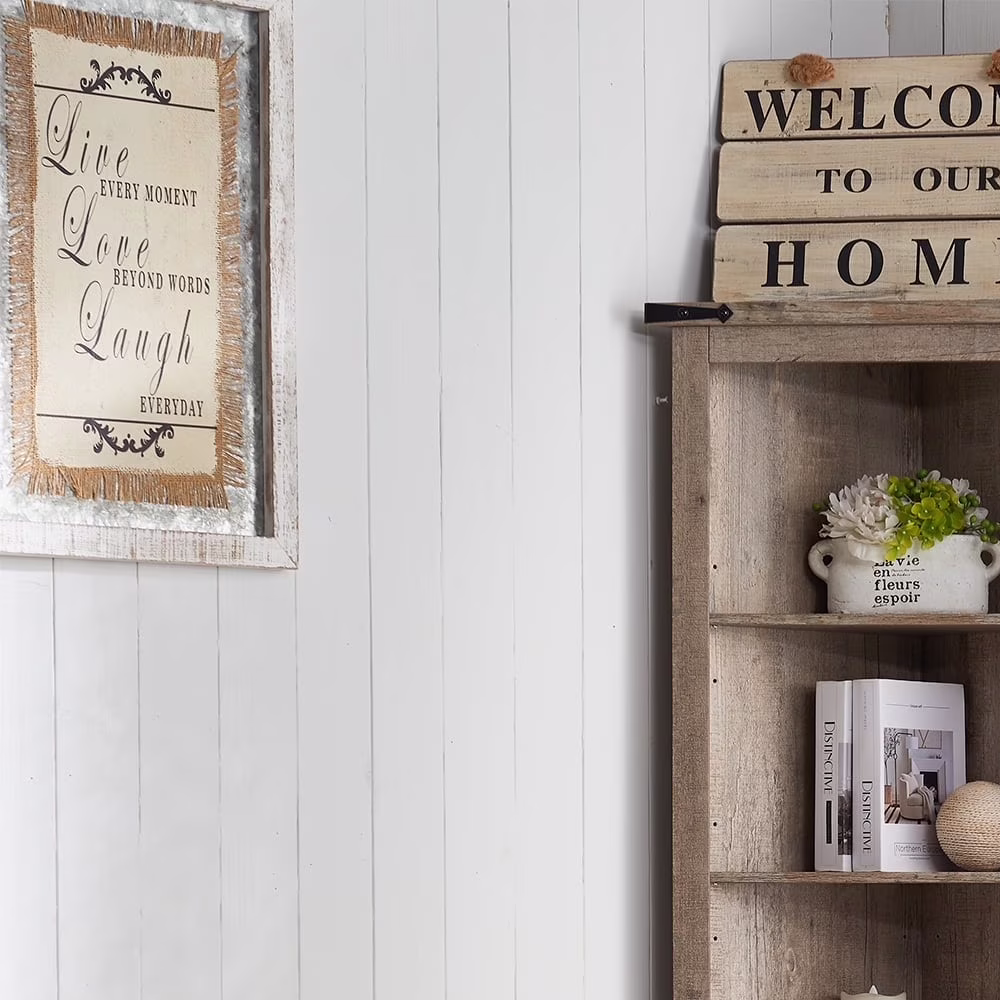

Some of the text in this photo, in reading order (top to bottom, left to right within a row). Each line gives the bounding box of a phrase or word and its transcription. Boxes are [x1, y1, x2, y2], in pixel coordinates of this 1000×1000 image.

[41, 93, 130, 178] Live
[100, 179, 198, 207] EVERY MOMENT
[815, 168, 872, 194] TO
[57, 185, 150, 268] Love
[113, 268, 210, 295] BEYOND WORDS
[74, 280, 194, 396] Laugh
[140, 396, 204, 417] EVERYDAY
[873, 569, 890, 578] en
[896, 555, 919, 566] vie
[874, 579, 920, 591] fleurs
[874, 592, 921, 606] espoir
[823, 721, 836, 795] DISTINCTIVE
[861, 781, 873, 853] DISTINCTIVE
[895, 844, 921, 852] Northern
